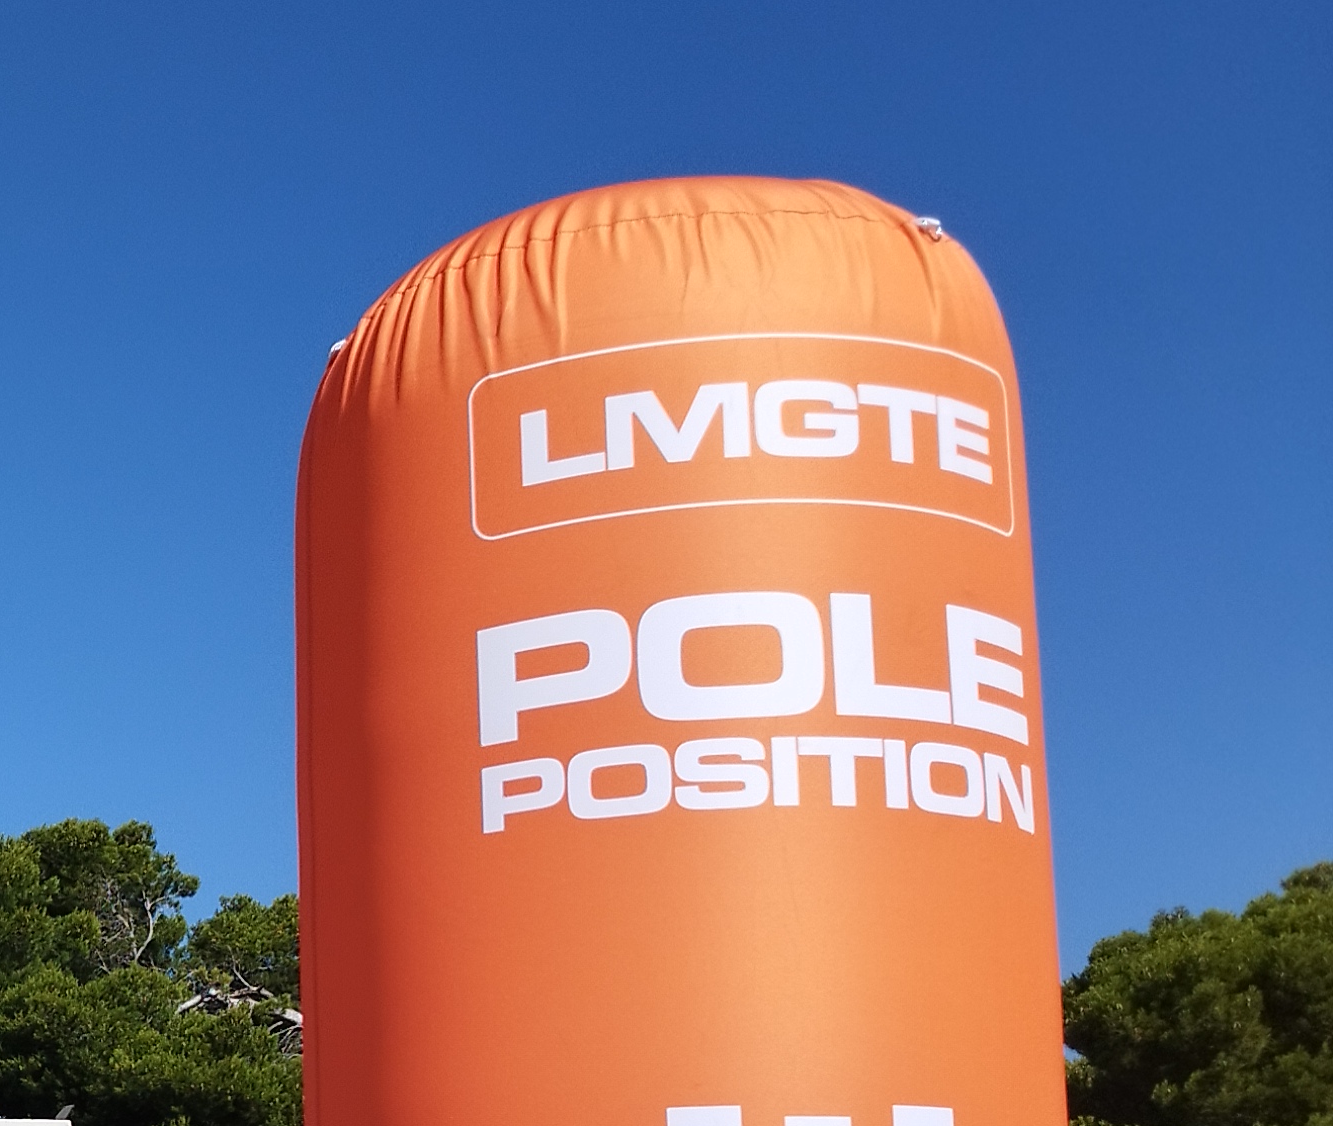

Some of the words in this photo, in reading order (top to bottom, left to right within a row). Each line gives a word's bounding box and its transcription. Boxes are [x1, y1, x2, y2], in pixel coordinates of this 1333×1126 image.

[519, 378, 994, 487] LMGTE
[475, 590, 1030, 747] POLE
[480, 735, 1036, 836] POSITION
